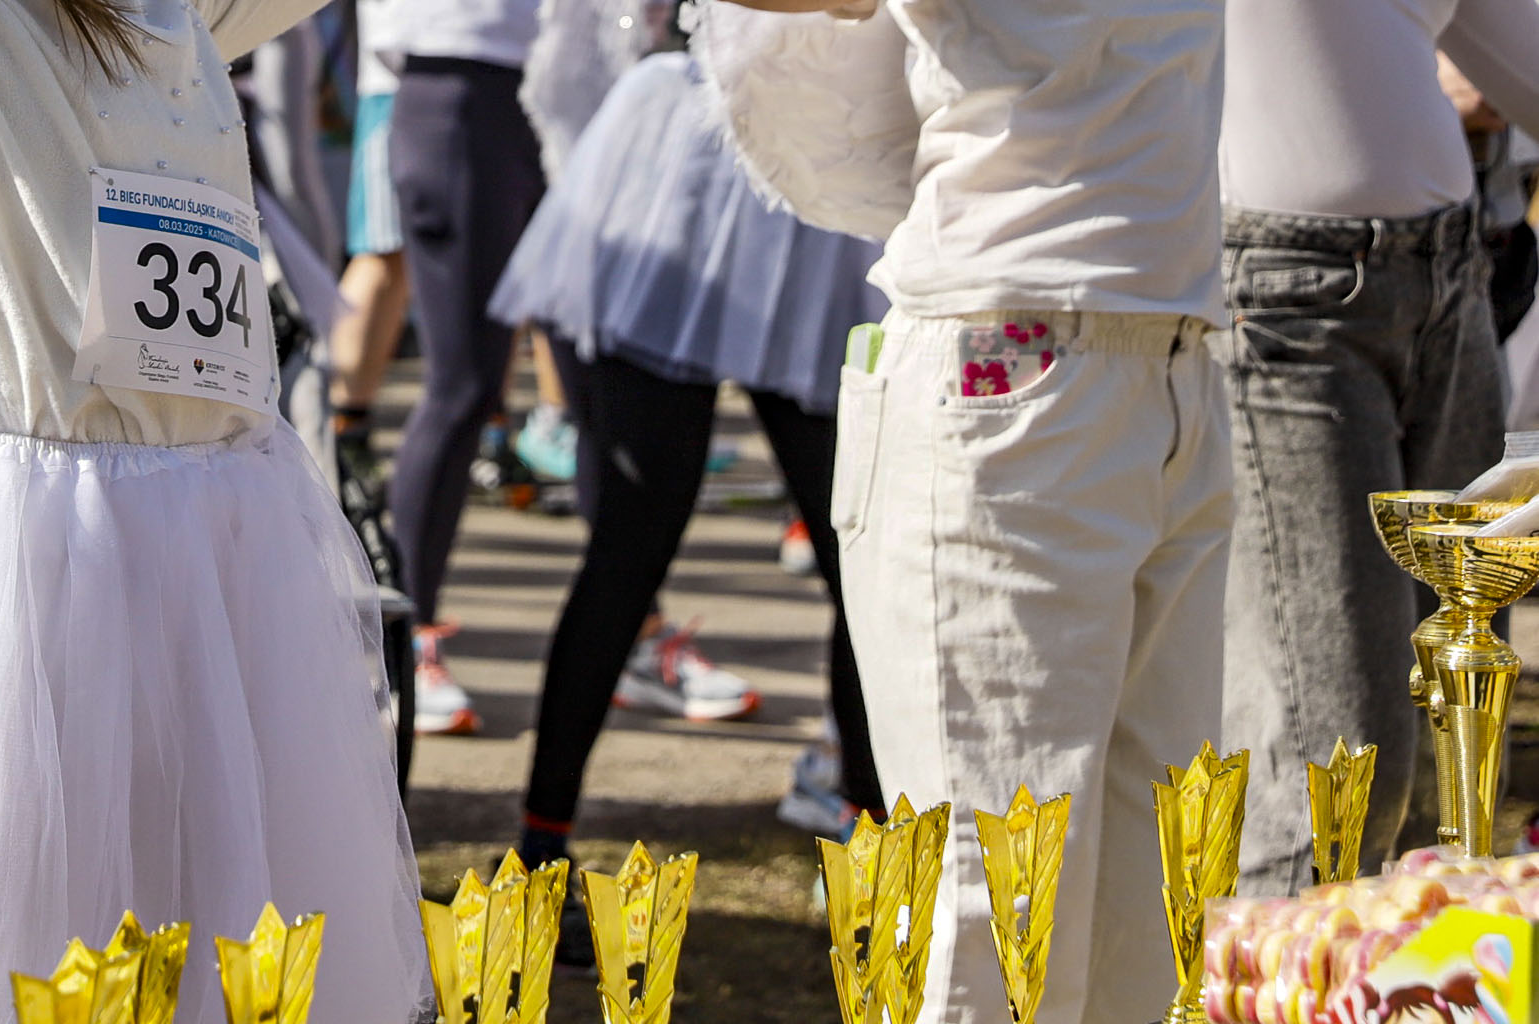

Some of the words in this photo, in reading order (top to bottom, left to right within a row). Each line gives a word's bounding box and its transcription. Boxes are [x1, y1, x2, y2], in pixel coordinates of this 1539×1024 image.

[105, 188, 119, 202] 12.
[119, 189, 141, 205] BIEG
[142, 192, 187, 211] FUNDACJI
[158, 218, 204, 236] 08.03.2025
[134, 242, 251, 348] 334
